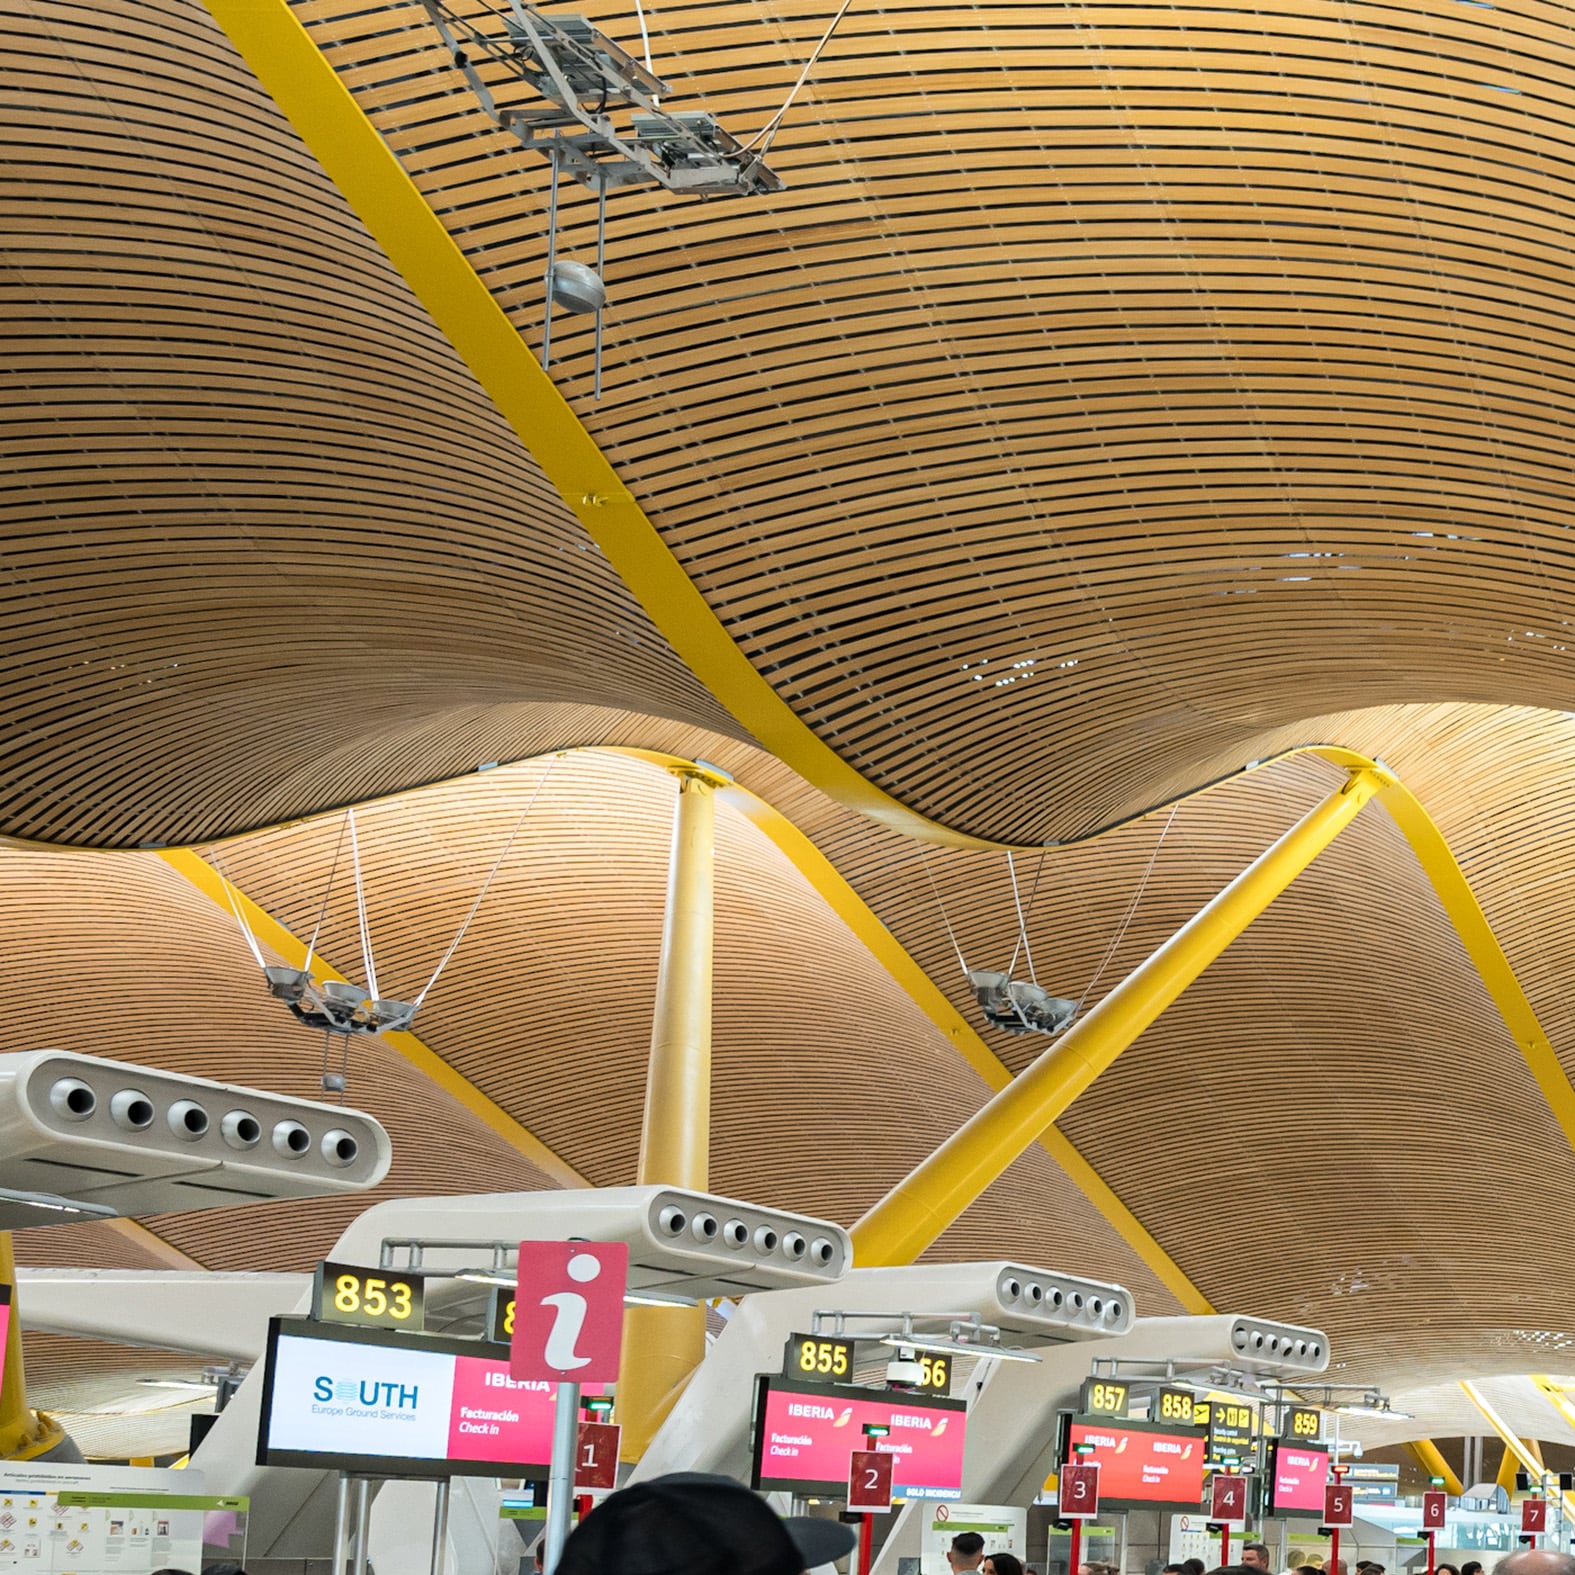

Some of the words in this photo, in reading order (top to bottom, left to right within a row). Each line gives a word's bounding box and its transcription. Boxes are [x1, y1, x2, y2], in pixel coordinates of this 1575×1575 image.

[333, 1275, 414, 1321] 853
[800, 1341, 847, 1375] 855
[918, 1357, 946, 1388] 56
[1093, 1384, 1126, 1412] 857
[1162, 1393, 1192, 1420] 858
[311, 1404, 343, 1417] Europe
[346, 1407, 378, 1420] Ground
[380, 1409, 417, 1422] Services
[460, 1406, 520, 1423] Facturación
[788, 1403, 835, 1420] IBERIA
[458, 1421, 488, 1436] Check
[488, 1424, 499, 1436] in
[890, 1413, 932, 1430] IBERIA
[1294, 1412, 1318, 1435] 859
[771, 1433, 813, 1446] Facturación
[1084, 1434, 1116, 1448] IBERIA
[1153, 1441, 1182, 1455] IBERIA
[1287, 1456, 1310, 1467] IBERIA
[864, 1469, 879, 1489] 2
[906, 1487, 925, 1497] SOLO
[1074, 1481, 1086, 1499] 3
[1223, 1490, 1235, 1507] 4
[1333, 1497, 1343, 1513] 5
[1430, 1503, 1440, 1518] 6
[1529, 1510, 1540, 1523] 7
